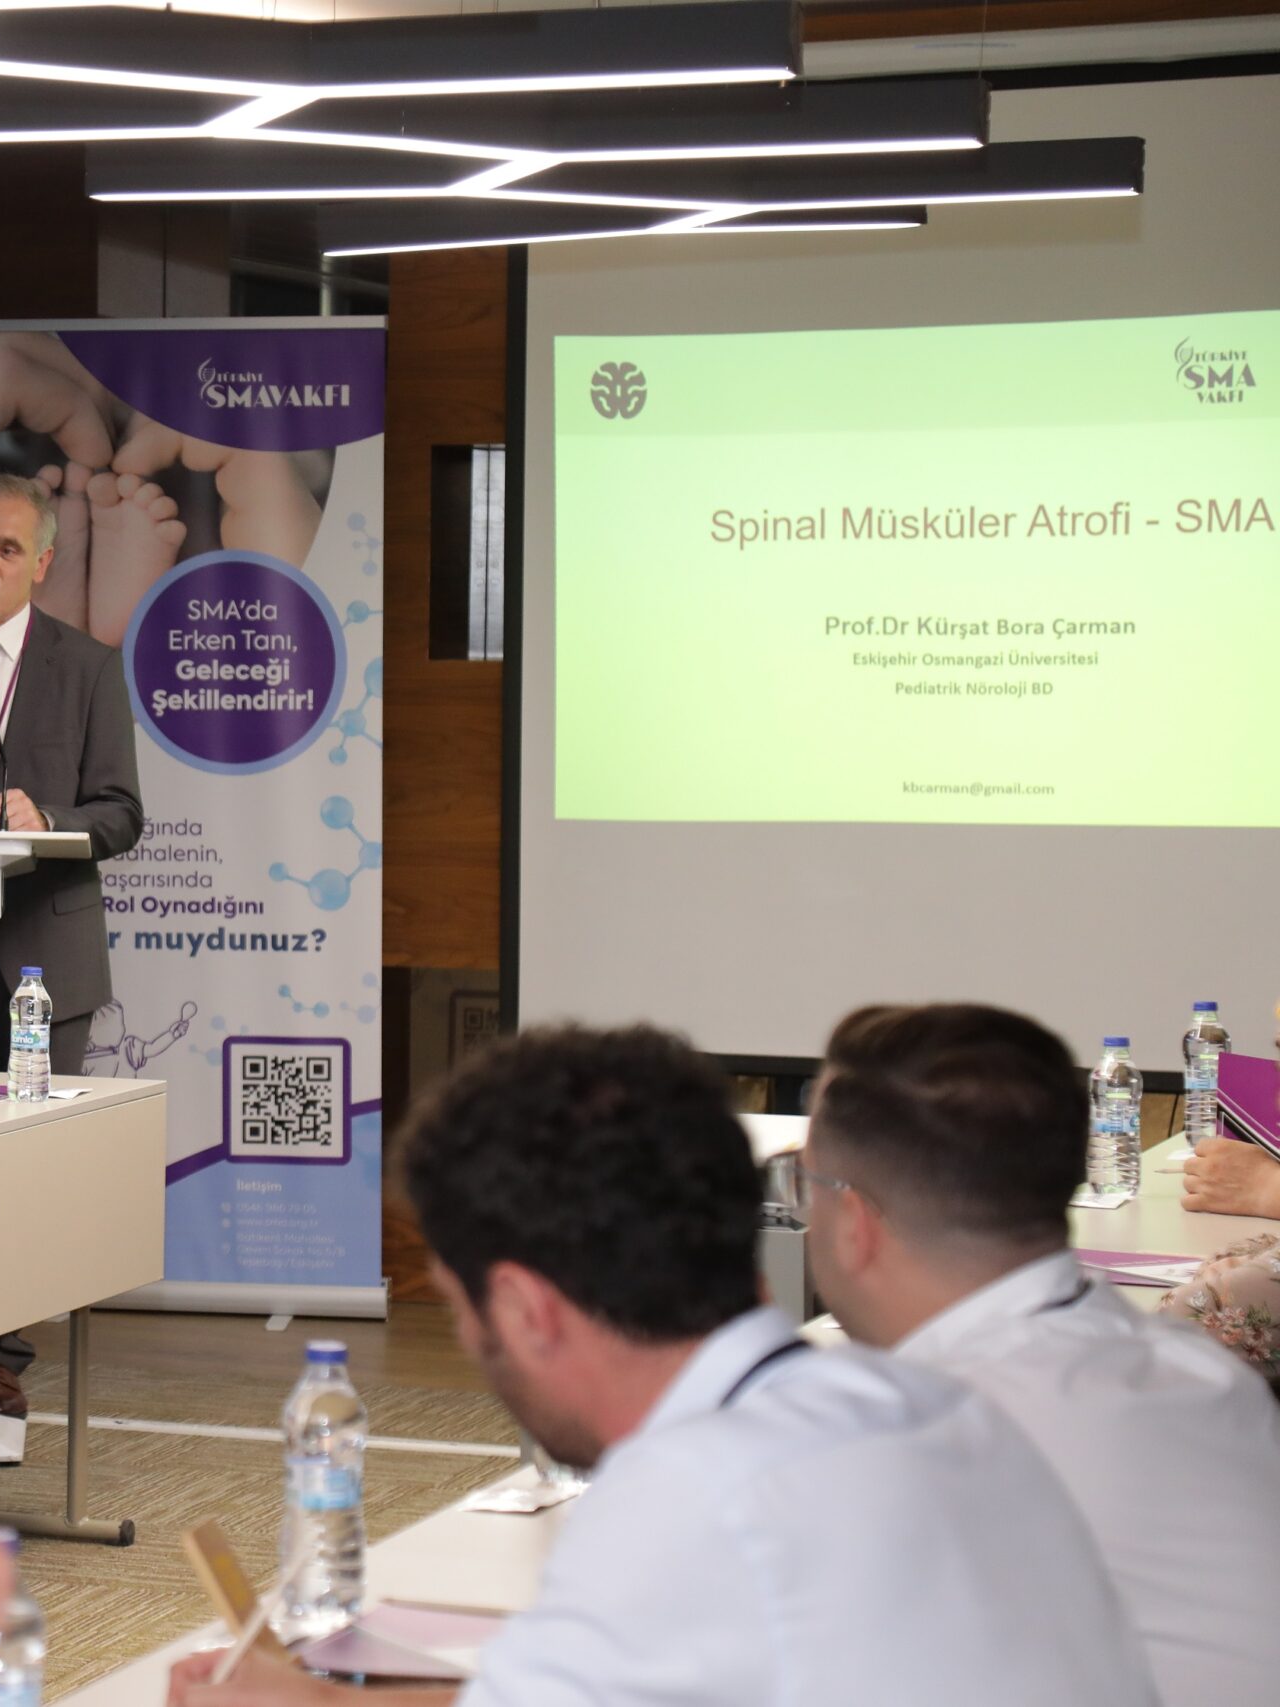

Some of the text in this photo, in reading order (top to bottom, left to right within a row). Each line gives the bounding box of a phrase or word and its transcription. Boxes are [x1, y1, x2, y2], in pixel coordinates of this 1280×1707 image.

[1183, 363, 1256, 390] SMA
[710, 507, 826, 550] Spinal
[841, 506, 1018, 540] Müsküler
[1026, 501, 1131, 538] Atrofi
[1175, 497, 1276, 534] SMA
[824, 616, 1137, 639] Prof.Dr Kürşat Bora Çarman
[168, 629, 298, 652] Erken Tanı,
[852, 650, 1099, 669] Eskişehir Osmangazi Üniversitesi
[175, 657, 291, 686] Geleceği
[894, 681, 1054, 698] Pediatrik Nöroloji BD
[151, 687, 315, 717] Şekillendirir!
[902, 781, 1055, 797] kbcarman@gmail.com
[142, 817, 203, 840] ğında
[113, 843, 224, 865] ahalenin,
[99, 870, 213, 892] aşarısında
[101, 895, 265, 919] Rol Oynadığını
[134, 927, 327, 957] muydunuz?
